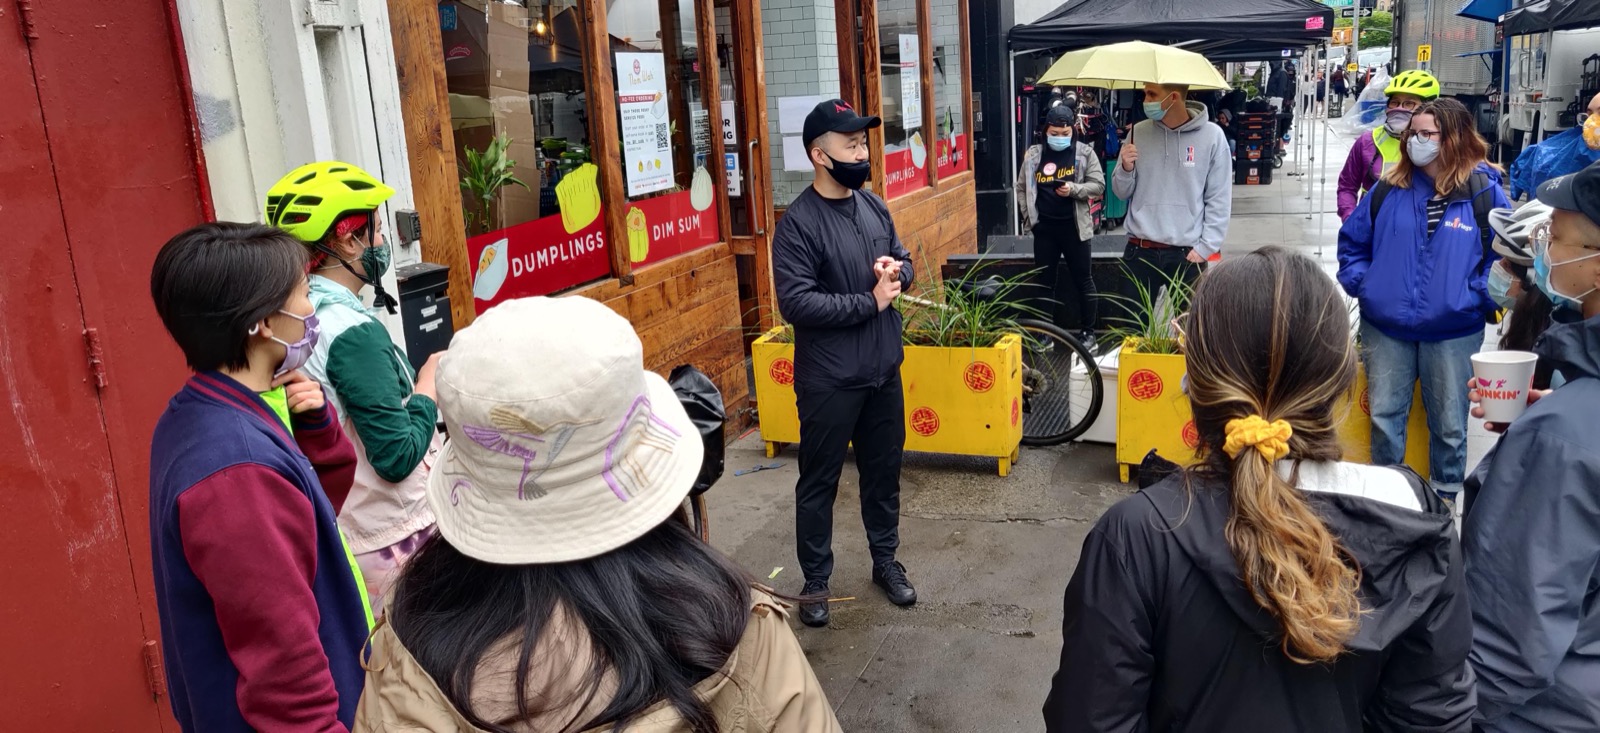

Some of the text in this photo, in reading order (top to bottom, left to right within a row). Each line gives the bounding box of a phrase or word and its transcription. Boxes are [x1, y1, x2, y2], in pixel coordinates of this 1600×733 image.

[937, 154, 948, 168] BEER
[885, 166, 915, 186] DUMPLINGS
[1036, 171, 1054, 183] Nom
[652, 214, 701, 241] DIM SUM
[512, 230, 604, 278] DUMPLINGS
